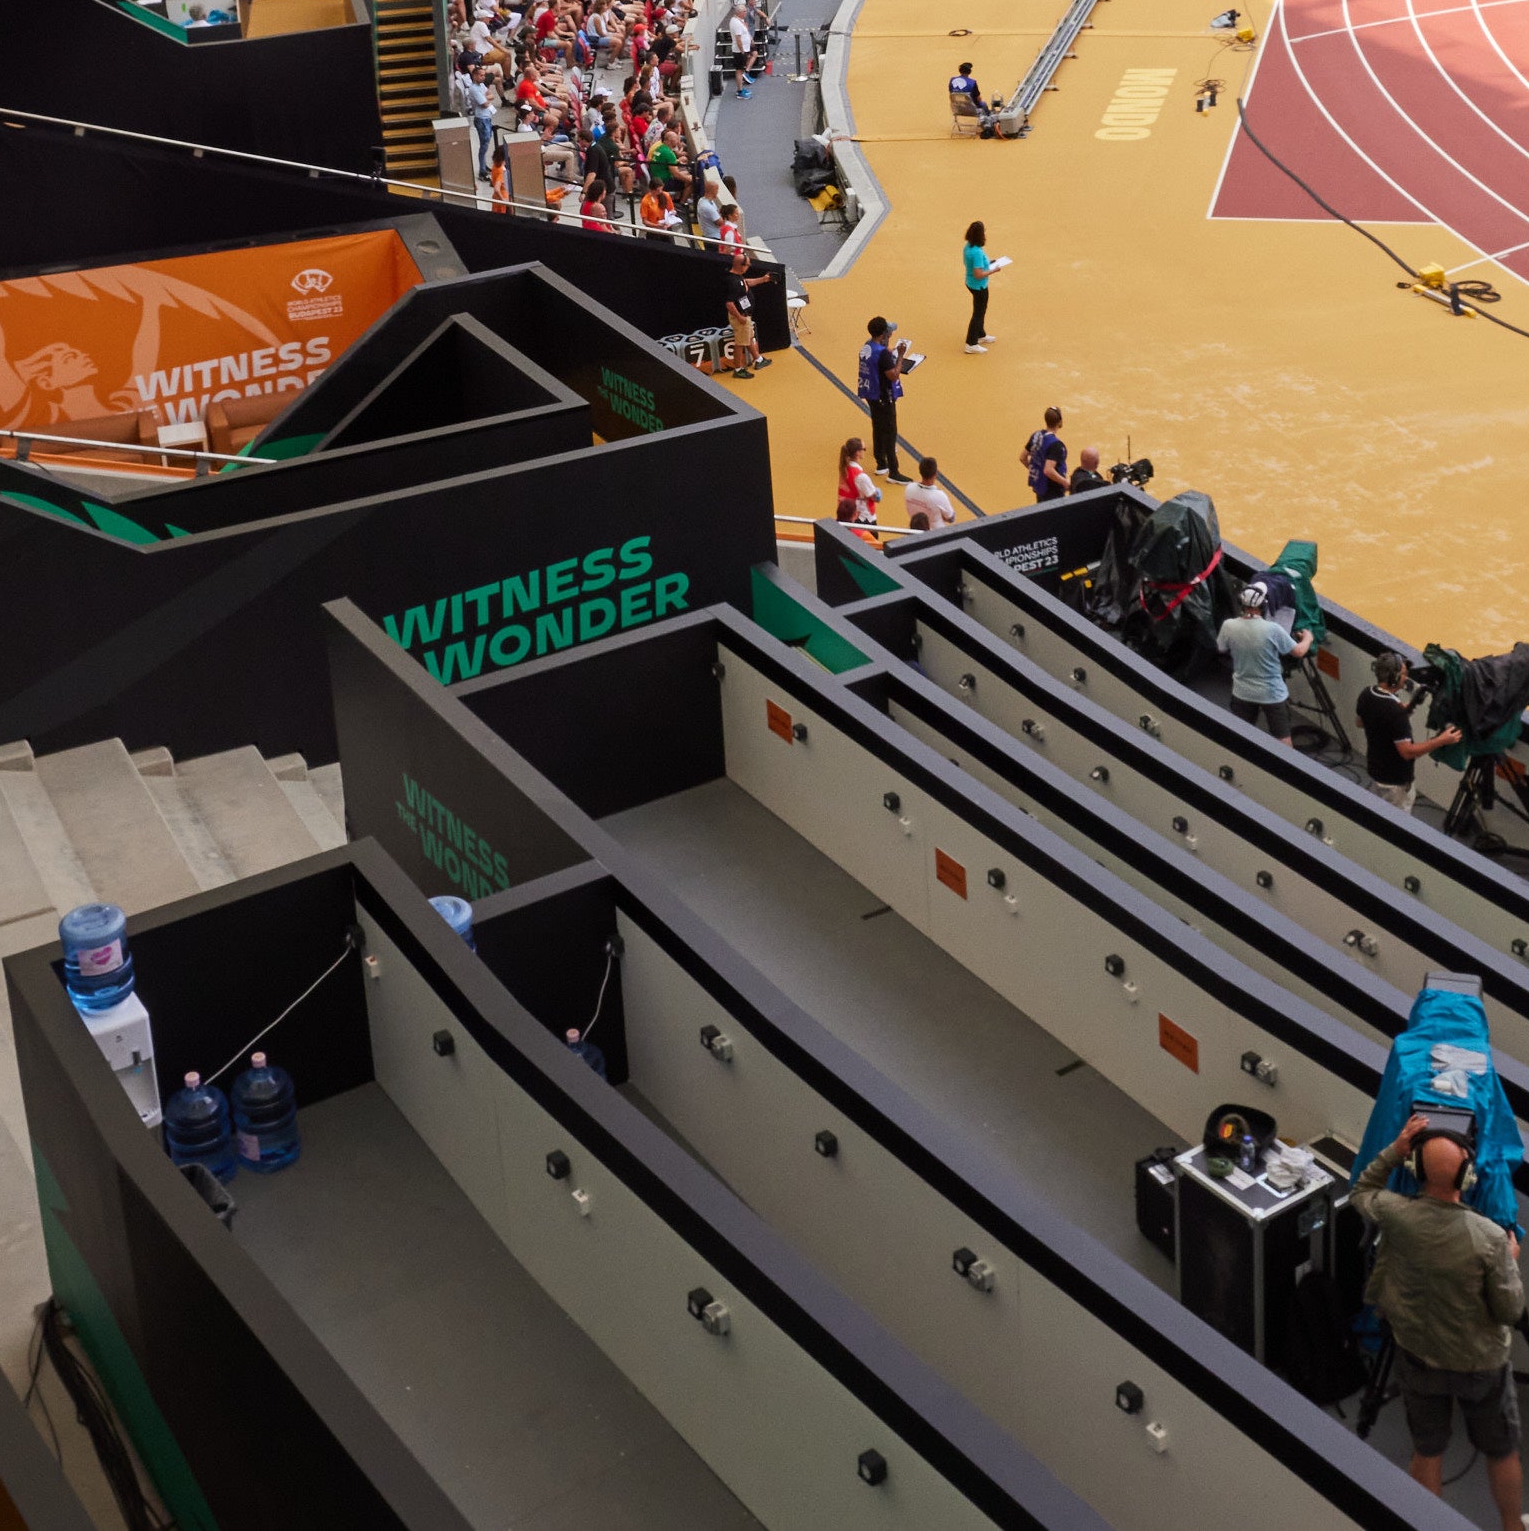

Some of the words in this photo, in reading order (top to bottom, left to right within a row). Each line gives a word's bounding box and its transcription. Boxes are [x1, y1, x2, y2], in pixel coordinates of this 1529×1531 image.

[1095, 68, 1178, 141] MONDO
[287, 301, 343, 313] CHAMPIONSHIPS
[288, 308, 332, 320] BUDAPEST
[332, 305, 344, 314] 23
[135, 337, 331, 402] WITNESS
[690, 349, 705, 368] 7
[600, 366, 656, 412] WITNESS
[1012, 536, 1058, 554] ATHLETICS
[1045, 555, 1059, 566] 23
[383, 536, 653, 650] WITNESS
[423, 572, 690, 687] WONDER
[402, 773, 510, 890] WITNESS
